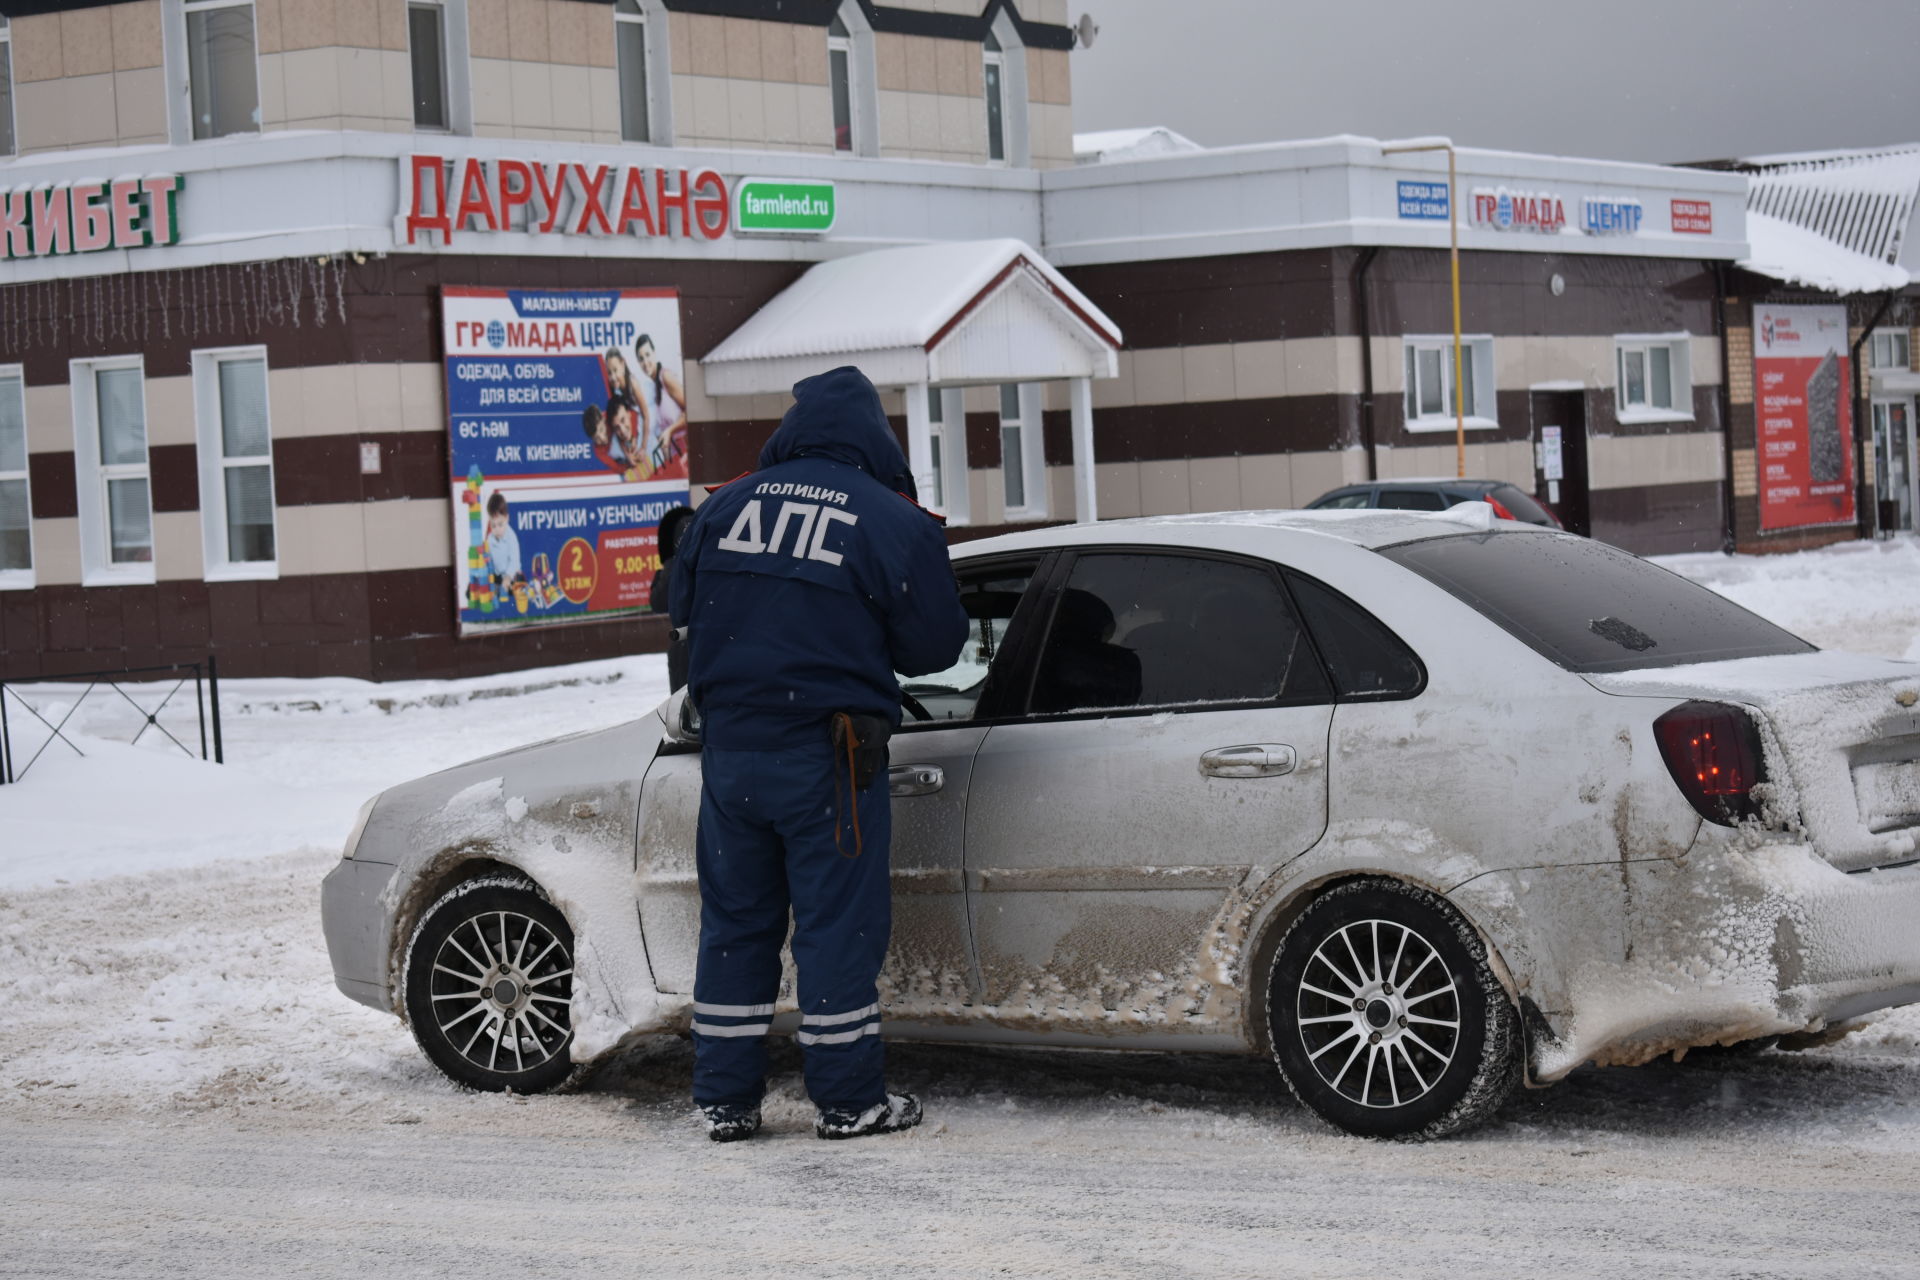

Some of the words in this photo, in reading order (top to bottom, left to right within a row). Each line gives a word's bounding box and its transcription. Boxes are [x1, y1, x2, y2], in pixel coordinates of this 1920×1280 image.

[406, 154, 729, 245] ДАРУХАНӘ
[746, 192, 829, 216] farmlend.ru
[0, 178, 184, 257] КИБЕТ
[1586, 201, 1643, 233] ЦЕНТР
[522, 297, 612, 312] МАГАЗИН-КИБЕТ
[580, 321, 635, 350] ЦЕНТР
[457, 363, 512, 381] ОДЕЖДА,
[514, 363, 555, 379] ОБУВЬ
[480, 388, 505, 406] ДЛЯ
[507, 384, 540, 403] ВСЕЙ
[541, 387, 582, 402] СЕМЬИ
[755, 482, 849, 506] ПОЛИЦИЯ
[517, 507, 587, 531] ИГРУШКИ
[718, 499, 858, 566] ДПС
[571, 546, 583, 572] 2
